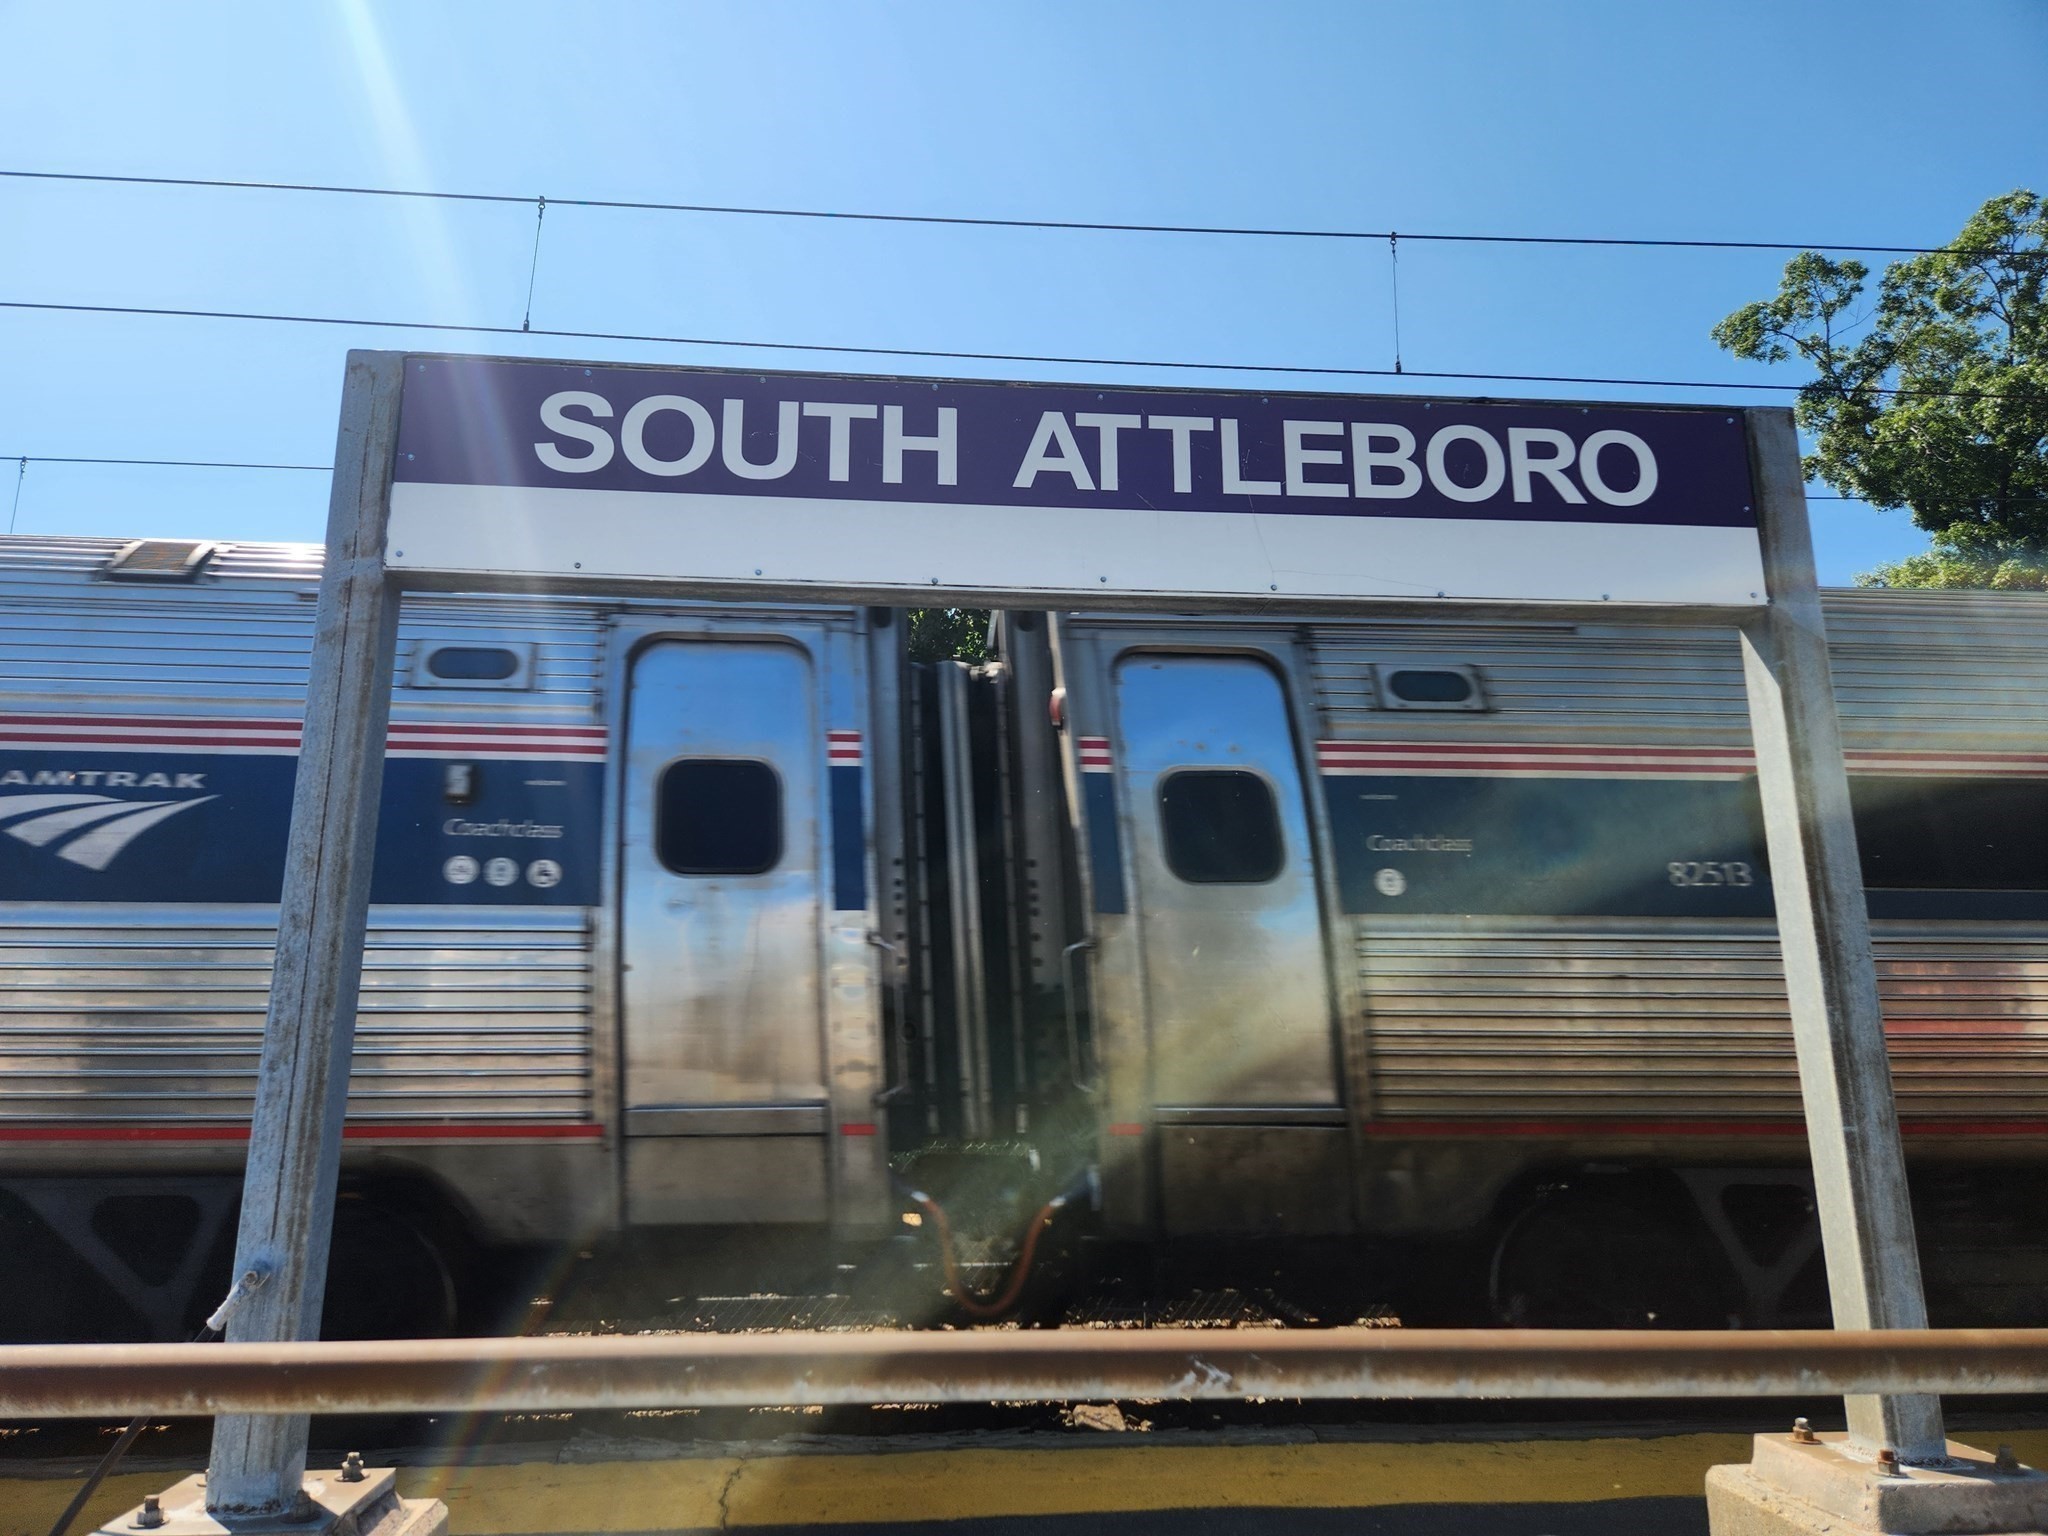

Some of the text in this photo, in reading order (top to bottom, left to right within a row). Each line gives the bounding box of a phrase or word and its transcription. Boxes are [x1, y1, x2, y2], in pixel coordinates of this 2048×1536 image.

[534, 390, 1659, 506] SOUTH ATTLEBORO
[0, 769, 208, 789] AMTRAK
[1666, 861, 1753, 887] 82513
